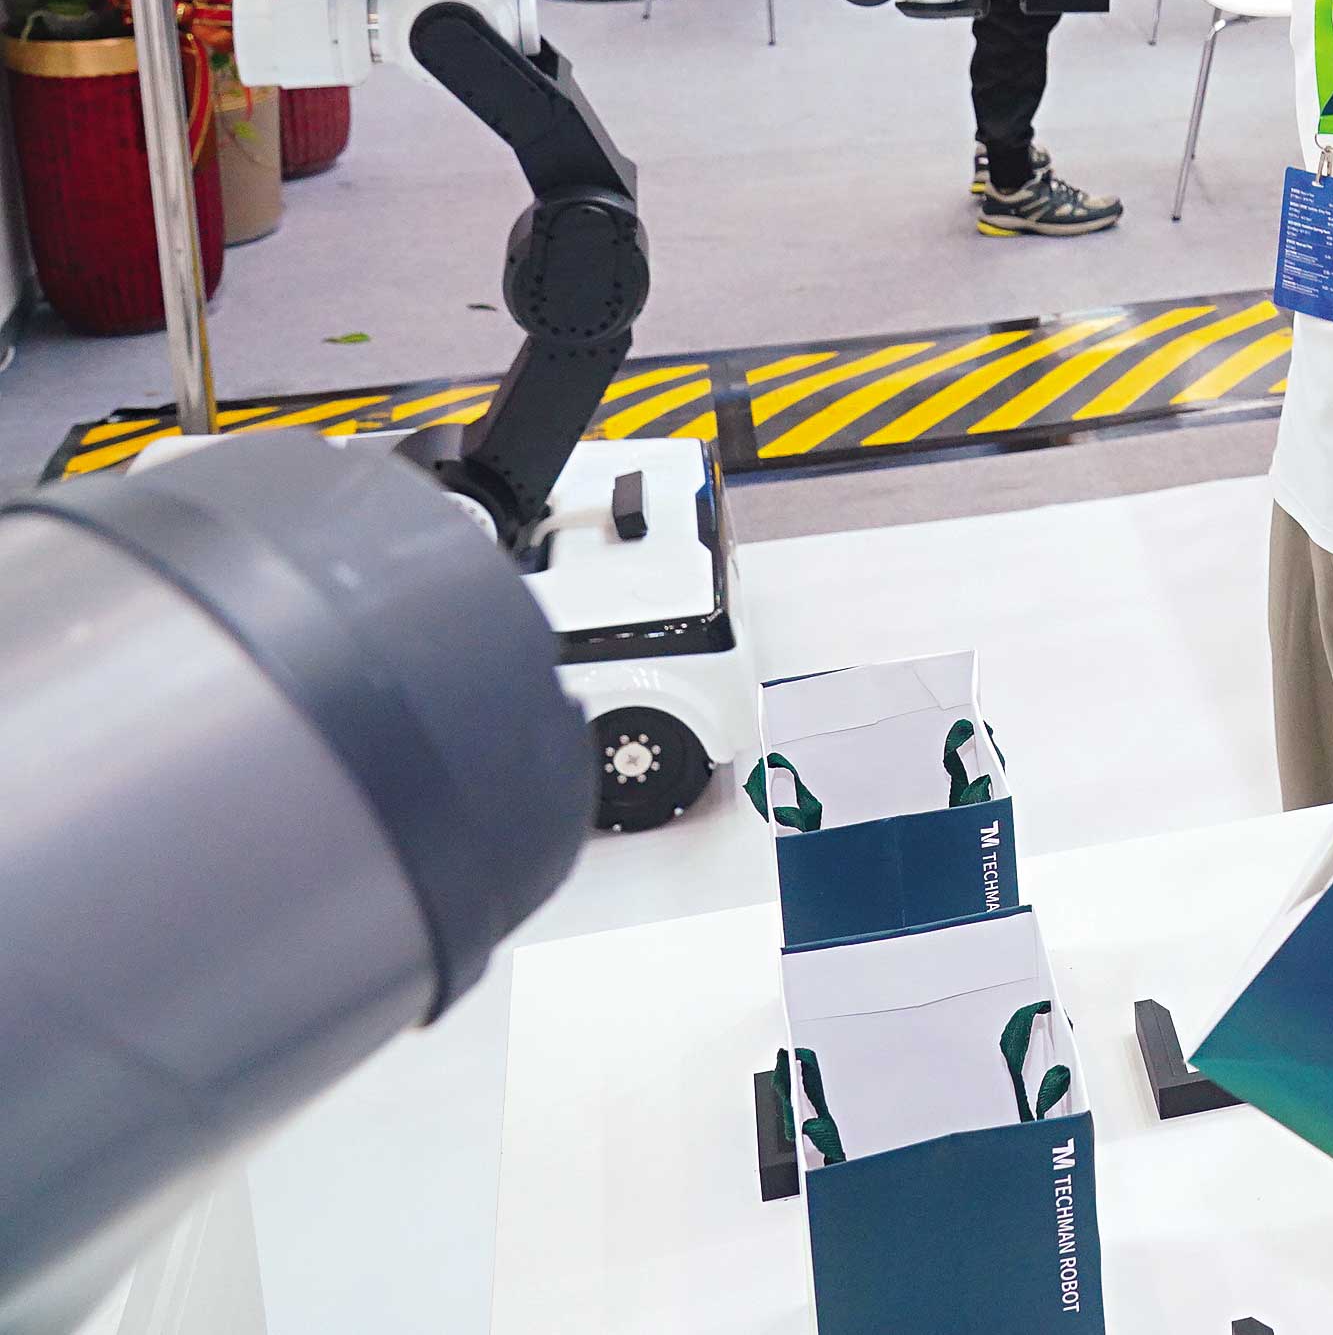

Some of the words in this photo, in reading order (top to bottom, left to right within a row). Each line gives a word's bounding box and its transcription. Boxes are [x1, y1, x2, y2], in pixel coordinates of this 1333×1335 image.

[979, 819, 1001, 849] TM
[1051, 1137, 1076, 1171] TM
[1053, 1173, 1077, 1255] TECHMAN
[1058, 1256, 1081, 1314] ROBOT
